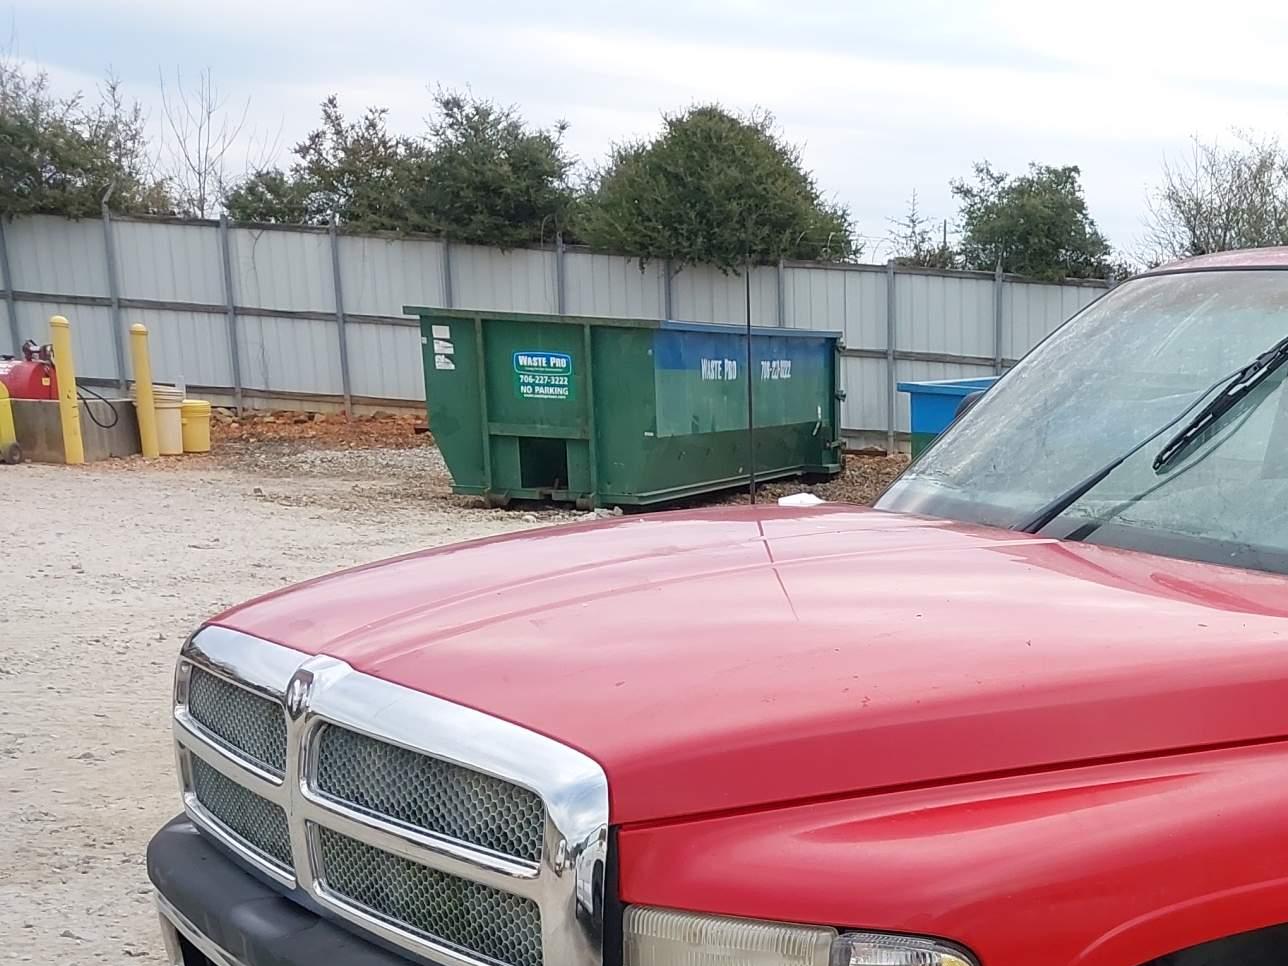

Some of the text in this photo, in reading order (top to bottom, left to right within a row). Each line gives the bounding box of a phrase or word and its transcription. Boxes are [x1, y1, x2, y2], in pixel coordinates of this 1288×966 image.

[518, 355, 567, 368] WASTE PRO
[701, 358, 722, 380] WASTE
[519, 374, 569, 385] 706-227-3222
[520, 385, 569, 395] NO PARKING
